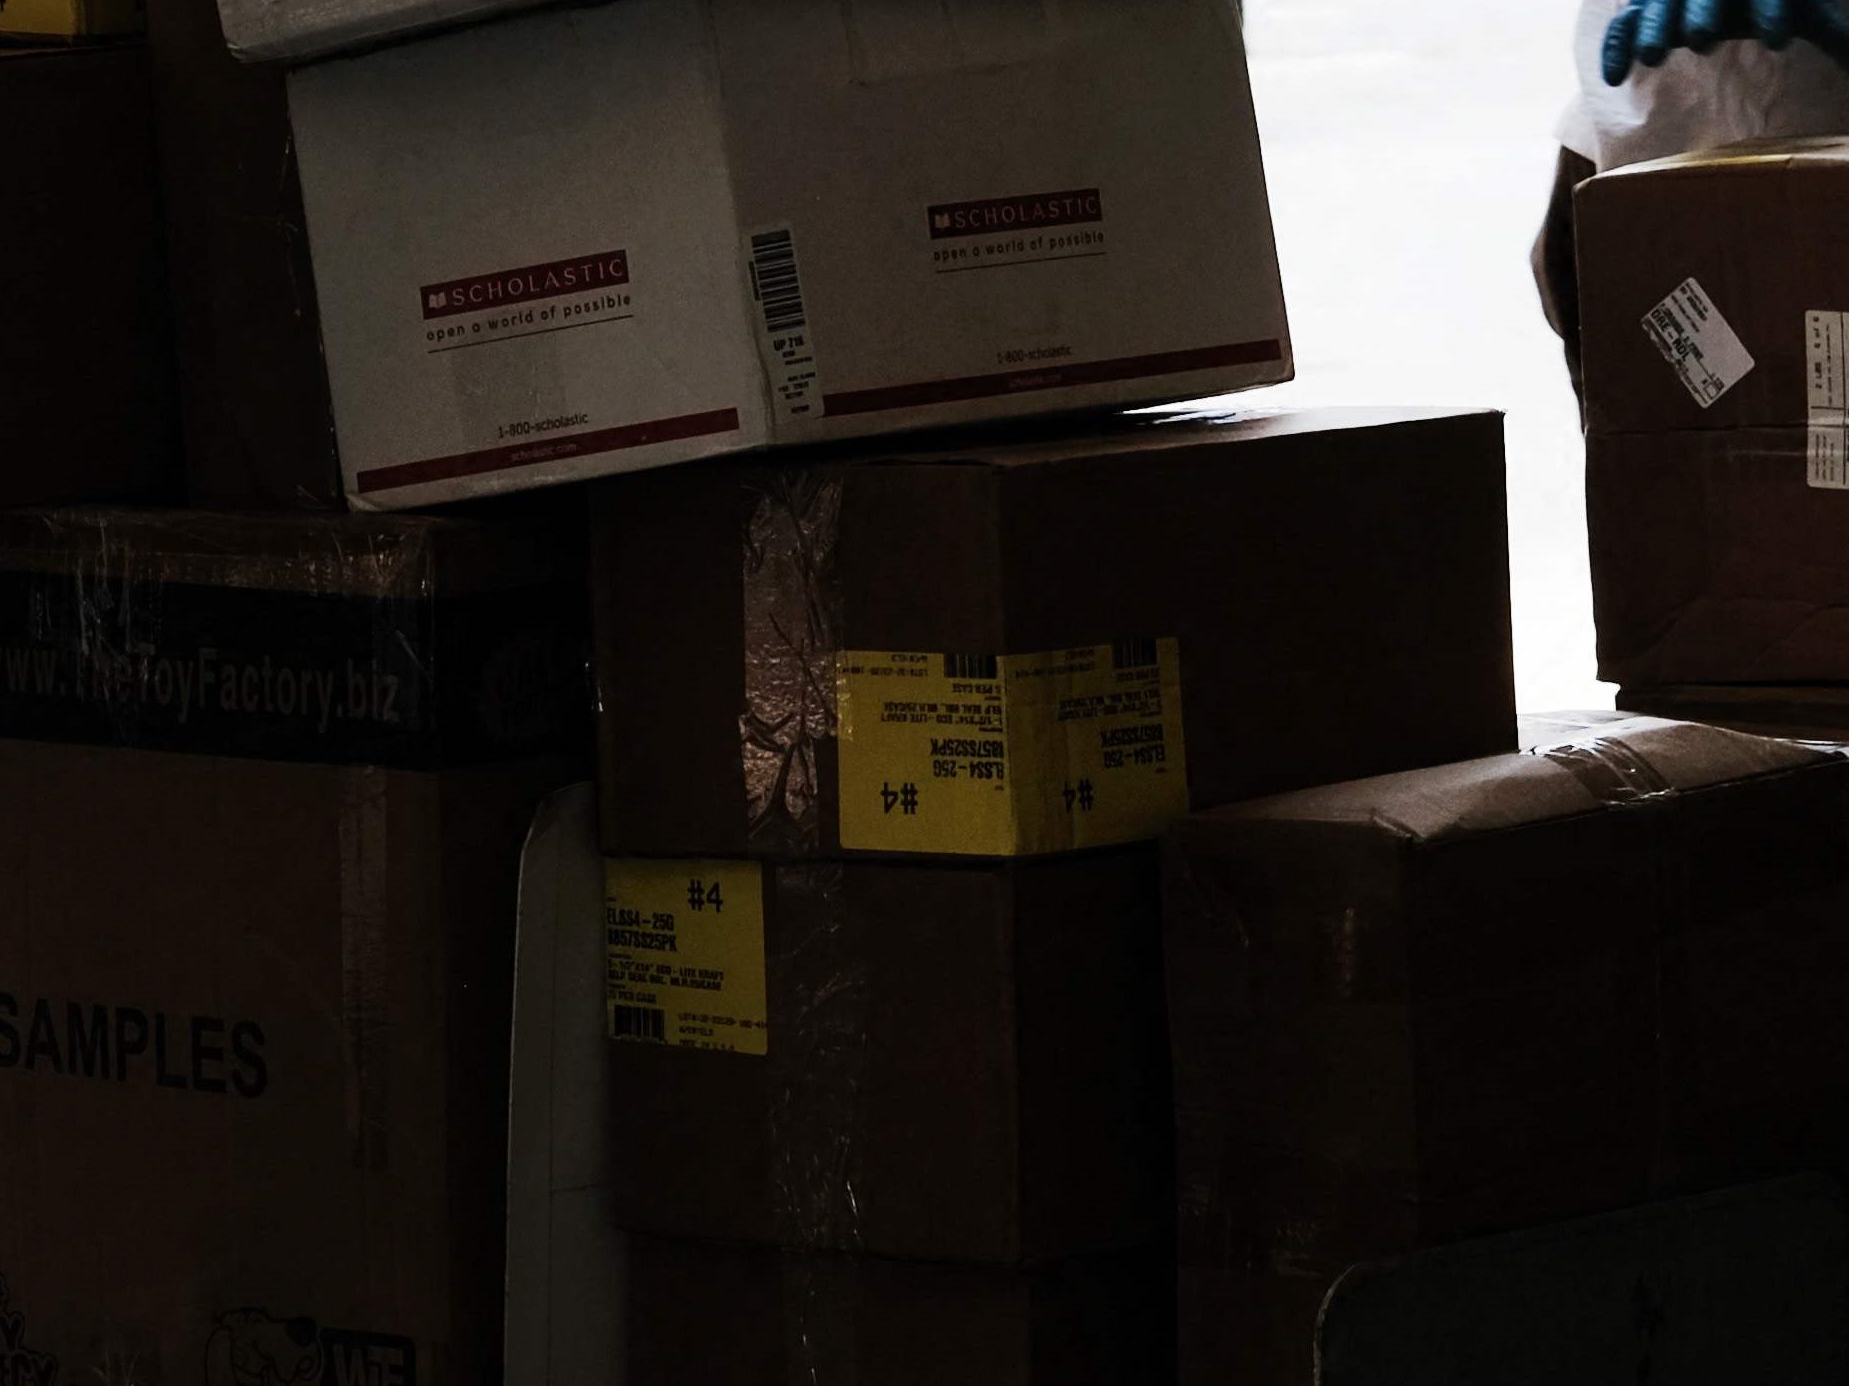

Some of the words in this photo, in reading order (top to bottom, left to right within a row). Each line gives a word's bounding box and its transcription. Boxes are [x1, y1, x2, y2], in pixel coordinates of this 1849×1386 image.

[953, 196, 1098, 230] SCHOLASTIC
[934, 246, 966, 262] open
[986, 239, 1025, 255] world
[1031, 237, 1043, 251] of
[1050, 230, 1104, 251] possible
[451, 258, 625, 307] SCHOLASTIC
[427, 324, 465, 342] open
[472, 323, 480, 332] a
[488, 311, 534, 331] world
[541, 306, 555, 320] of
[563, 294, 632, 320] possible
[774, 338, 786, 351] UP
[498, 412, 589, 439] 1-800-scholastic
[881, 781, 918, 814] #4
[1063, 778, 1094, 813] #4
[687, 878, 724, 913] #4
